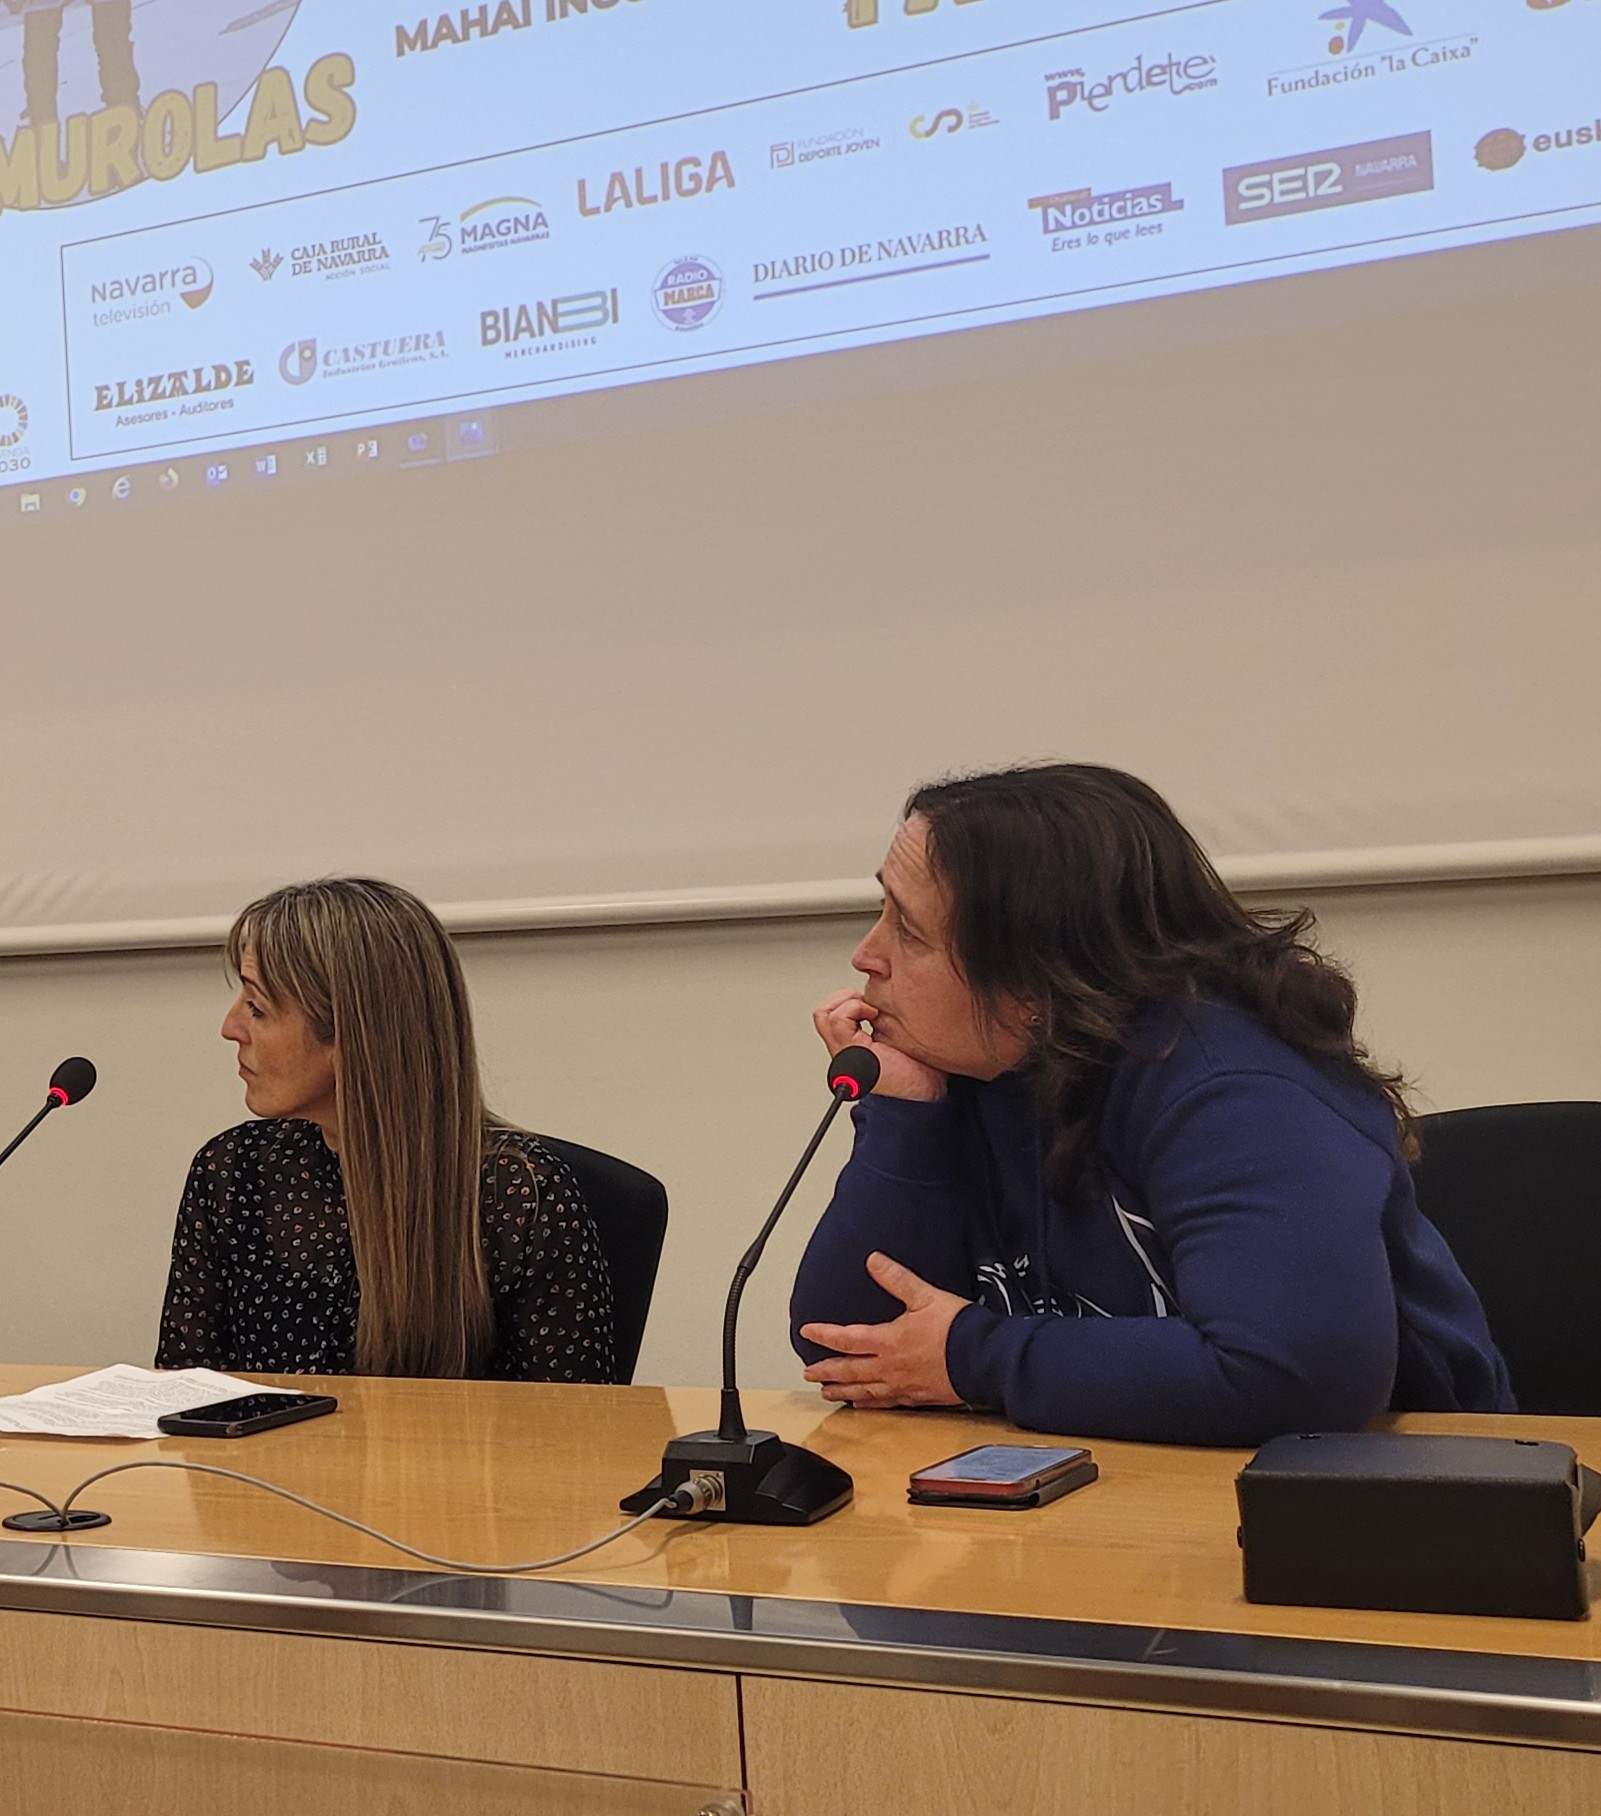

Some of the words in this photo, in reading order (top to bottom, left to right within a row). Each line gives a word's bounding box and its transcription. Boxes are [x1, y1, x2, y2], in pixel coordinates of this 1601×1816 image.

[395, 0, 531, 57] MAHAI
[1267, 61, 1376, 97] Fundación
[799, 145, 842, 162] DEPORTE
[845, 137, 880, 154] JOVEN
[576, 149, 737, 218] LALIGA
[1238, 162, 1342, 210] SER
[461, 211, 549, 245] MAGNA
[1047, 193, 1164, 231] Noticias
[291, 243, 327, 260] CAJA
[330, 232, 382, 253] RURAL
[752, 250, 835, 283] DIARIO
[840, 244, 872, 268] DE
[876, 223, 988, 261] NAVARRA
[1052, 236, 1081, 252] Eres
[1087, 231, 1099, 246] lo
[1104, 229, 1131, 246] que
[1135, 222, 1164, 238] lees
[291, 260, 312, 276] DE
[317, 246, 389, 272] NAVARRA
[90, 264, 198, 304] Navarra
[667, 269, 708, 286] RADIO
[663, 283, 715, 307] MARCA
[93, 299, 171, 327] televisión
[323, 330, 446, 367] CASTUERA
[504, 336, 597, 360] MERCHANDISING
[115, 408, 169, 428] Asesores
[178, 398, 235, 417] Auditores
